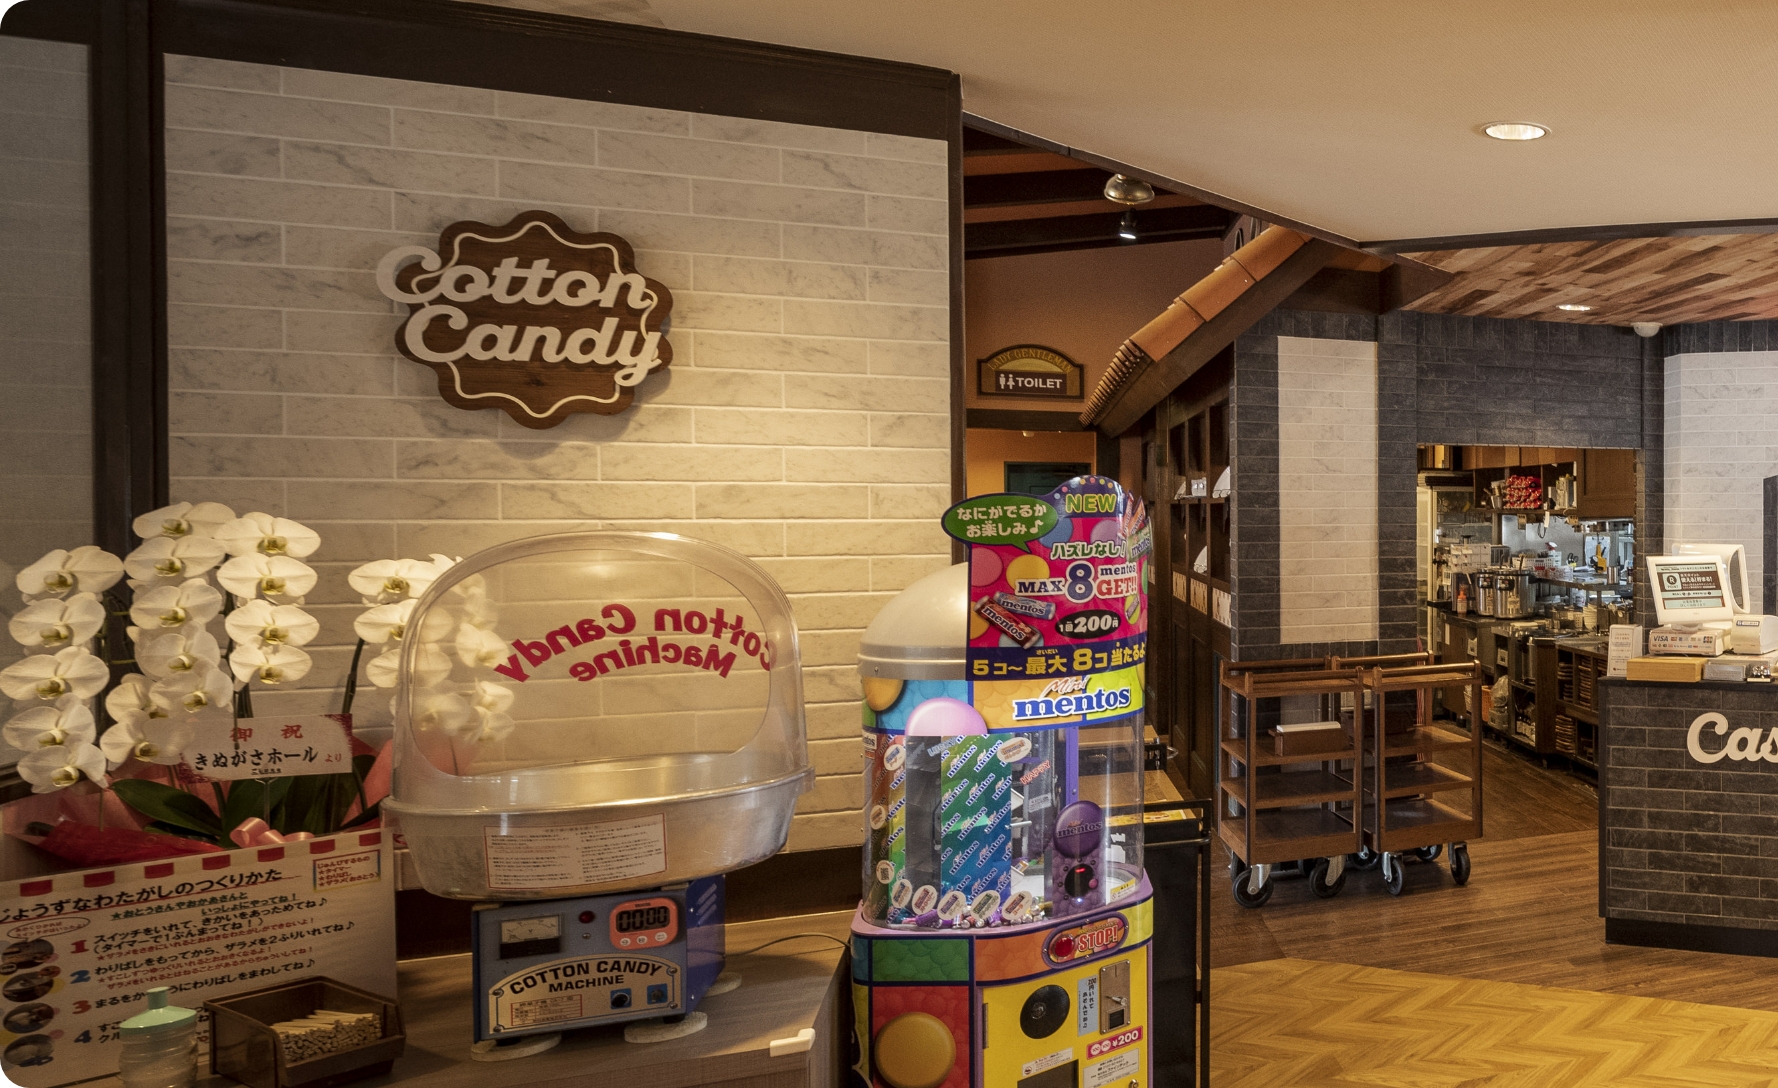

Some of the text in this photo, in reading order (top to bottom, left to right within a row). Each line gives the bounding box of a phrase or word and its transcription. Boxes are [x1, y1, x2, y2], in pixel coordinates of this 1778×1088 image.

[376, 245, 654, 310] Cotton
[404, 304, 662, 387] Candy
[1016, 377, 1063, 389] TOILET
[957, 504, 1047, 520] なにがでるか
[1065, 493, 1118, 513] NEW
[966, 522, 1028, 538] お楽しみ
[1100, 564, 1136, 576] mentos
[1017, 562, 1094, 603] MAX 8
[981, 606, 1026, 640] mentos
[1000, 608, 1046, 625] mentos
[1013, 687, 1131, 721] mentos
[229, 724, 304, 742] 御 祝
[195, 746, 342, 770] きぬがさホール より
[947, 745, 977, 778] mentos
[974, 740, 1003, 773] mentos
[1020, 759, 1051, 785] HAPPY
[966, 773, 995, 806] mentos
[957, 806, 988, 840] mentos
[1057, 821, 1103, 838] mentos
[950, 841, 979, 875] mentos
[976, 834, 1006, 868] mentos
[70, 940, 89, 954] 1
[1078, 925, 1118, 952] STOP!
[69, 970, 91, 984] 2
[510, 960, 663, 994] COTTON CANDY
[549, 975, 625, 993] MACHINE
[71, 1000, 91, 1014] 3
[73, 1030, 91, 1043] 4
[1112, 1030, 1139, 1047] ¥200
